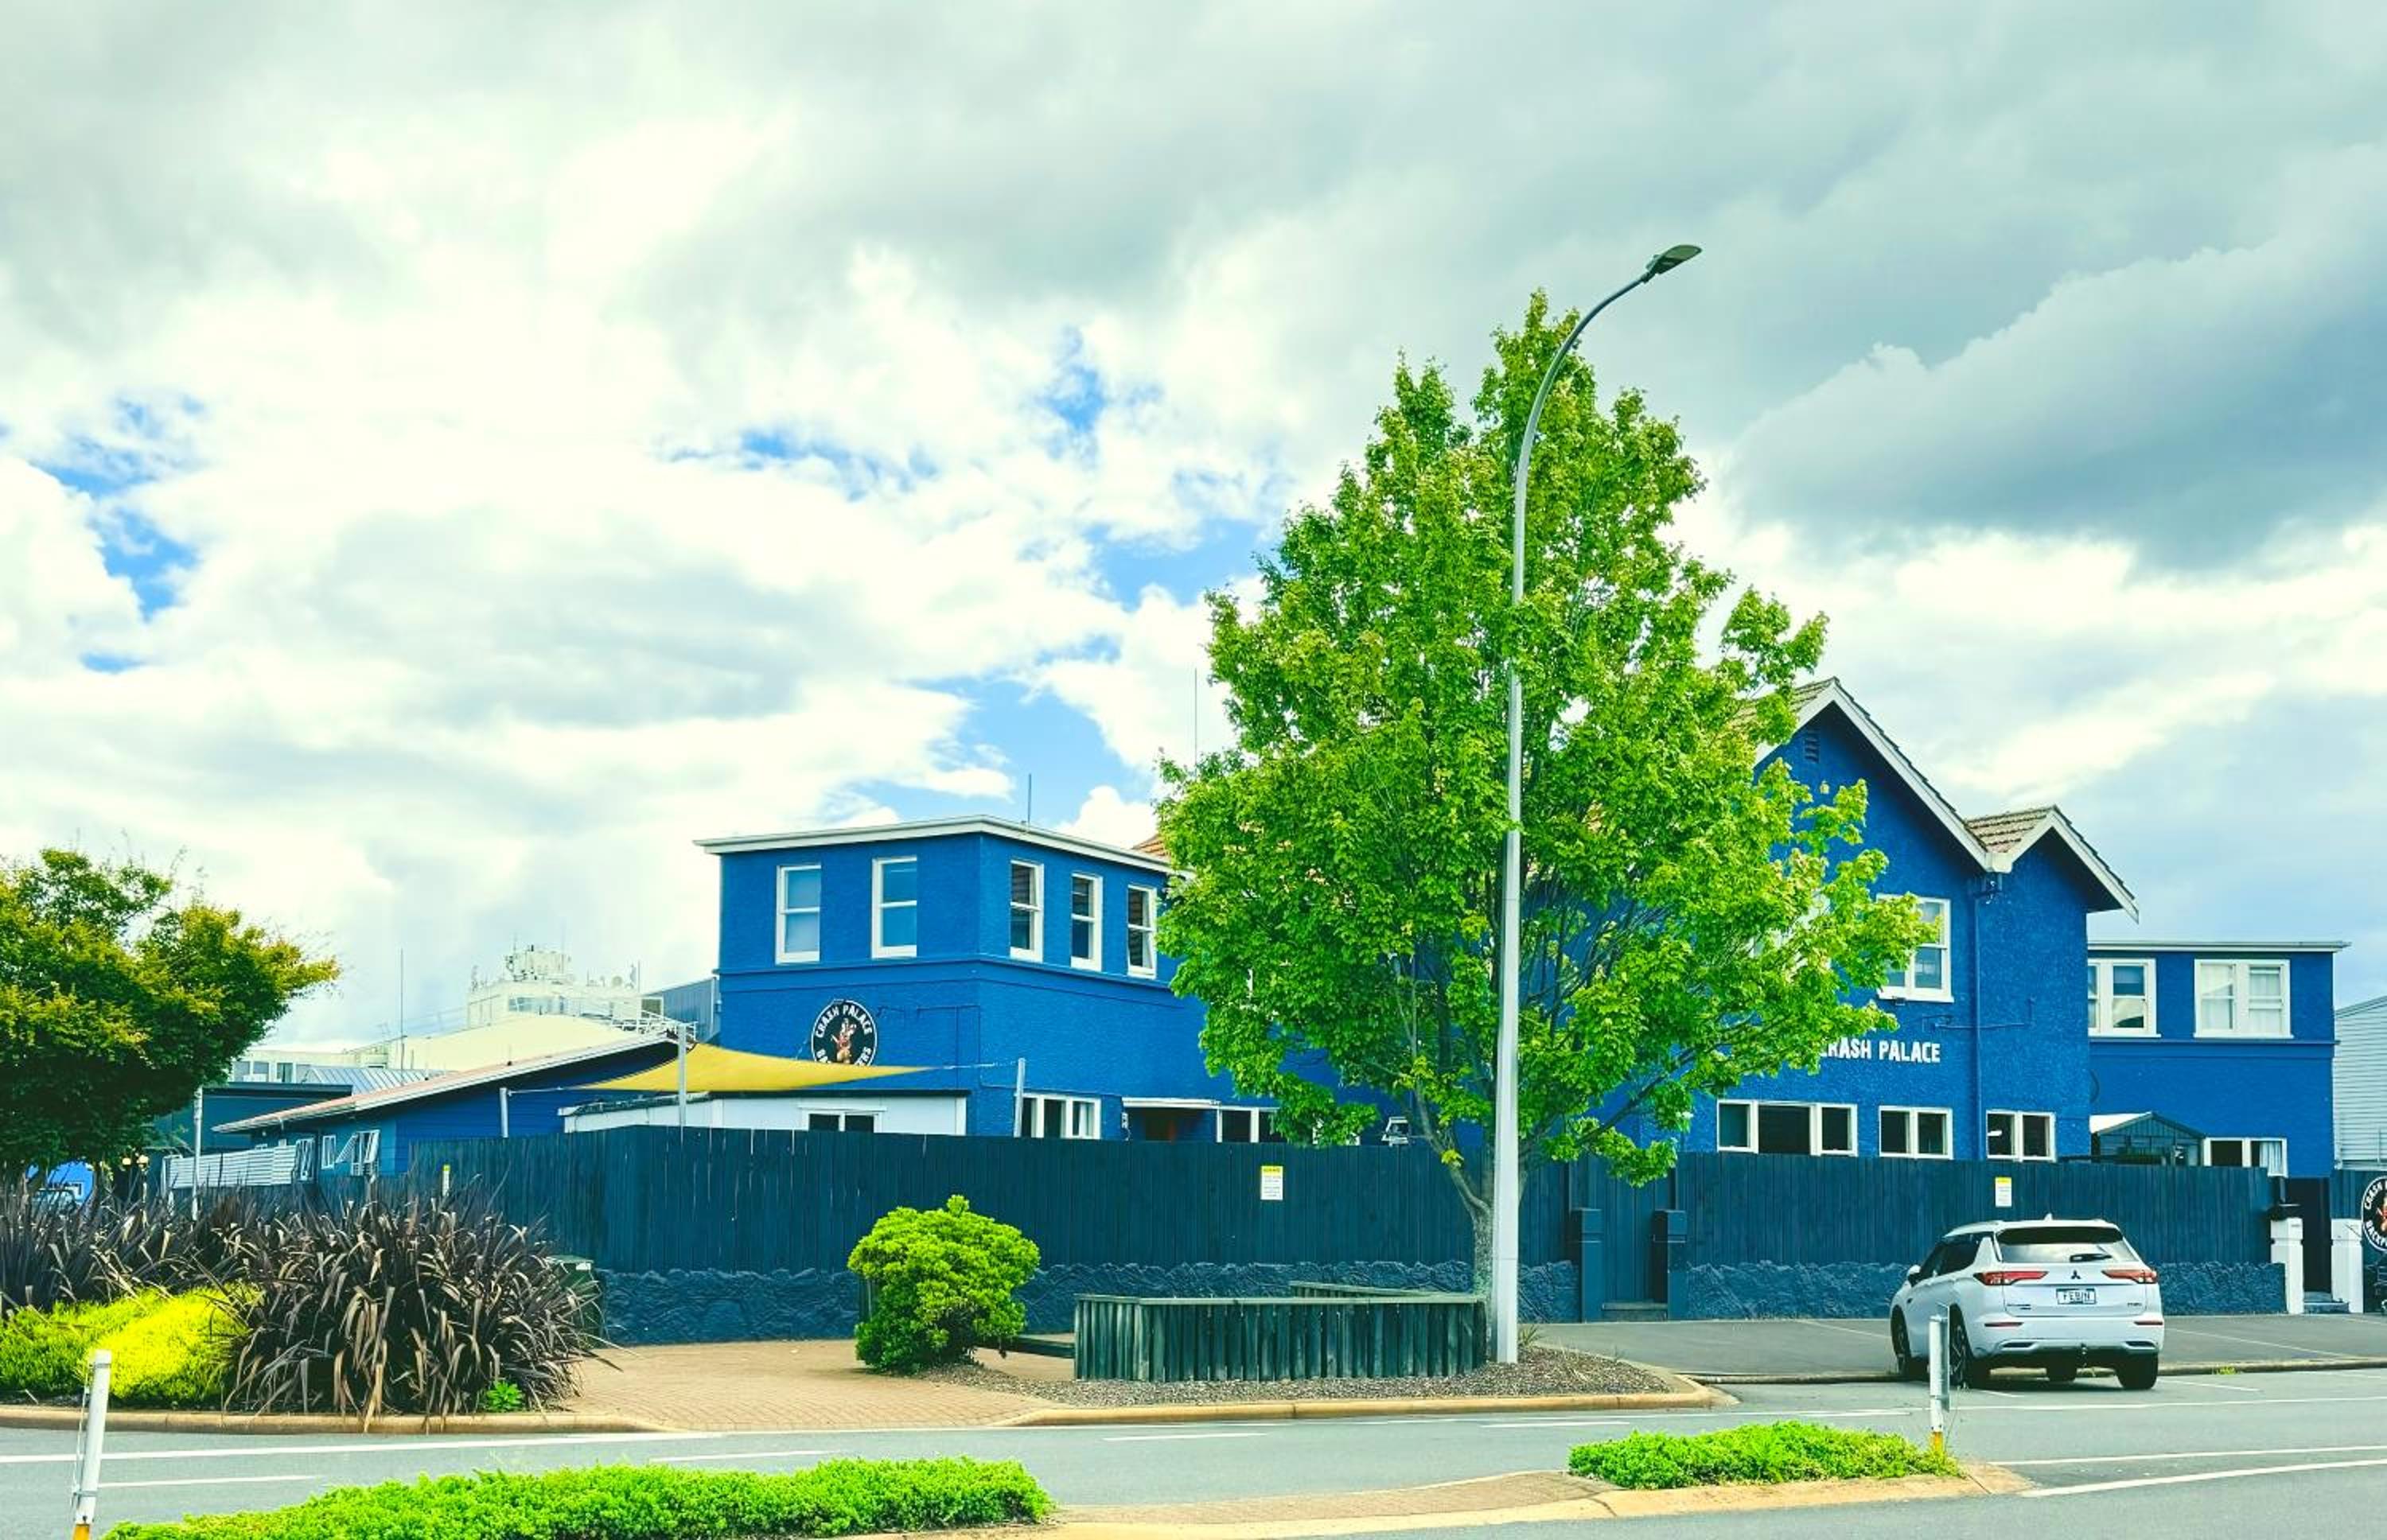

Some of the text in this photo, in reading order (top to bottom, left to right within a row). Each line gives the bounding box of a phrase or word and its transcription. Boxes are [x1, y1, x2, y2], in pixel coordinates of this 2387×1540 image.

[816, 1005, 873, 1038] CRASH PALACE
[1879, 1040, 1941, 1064] PALACE
